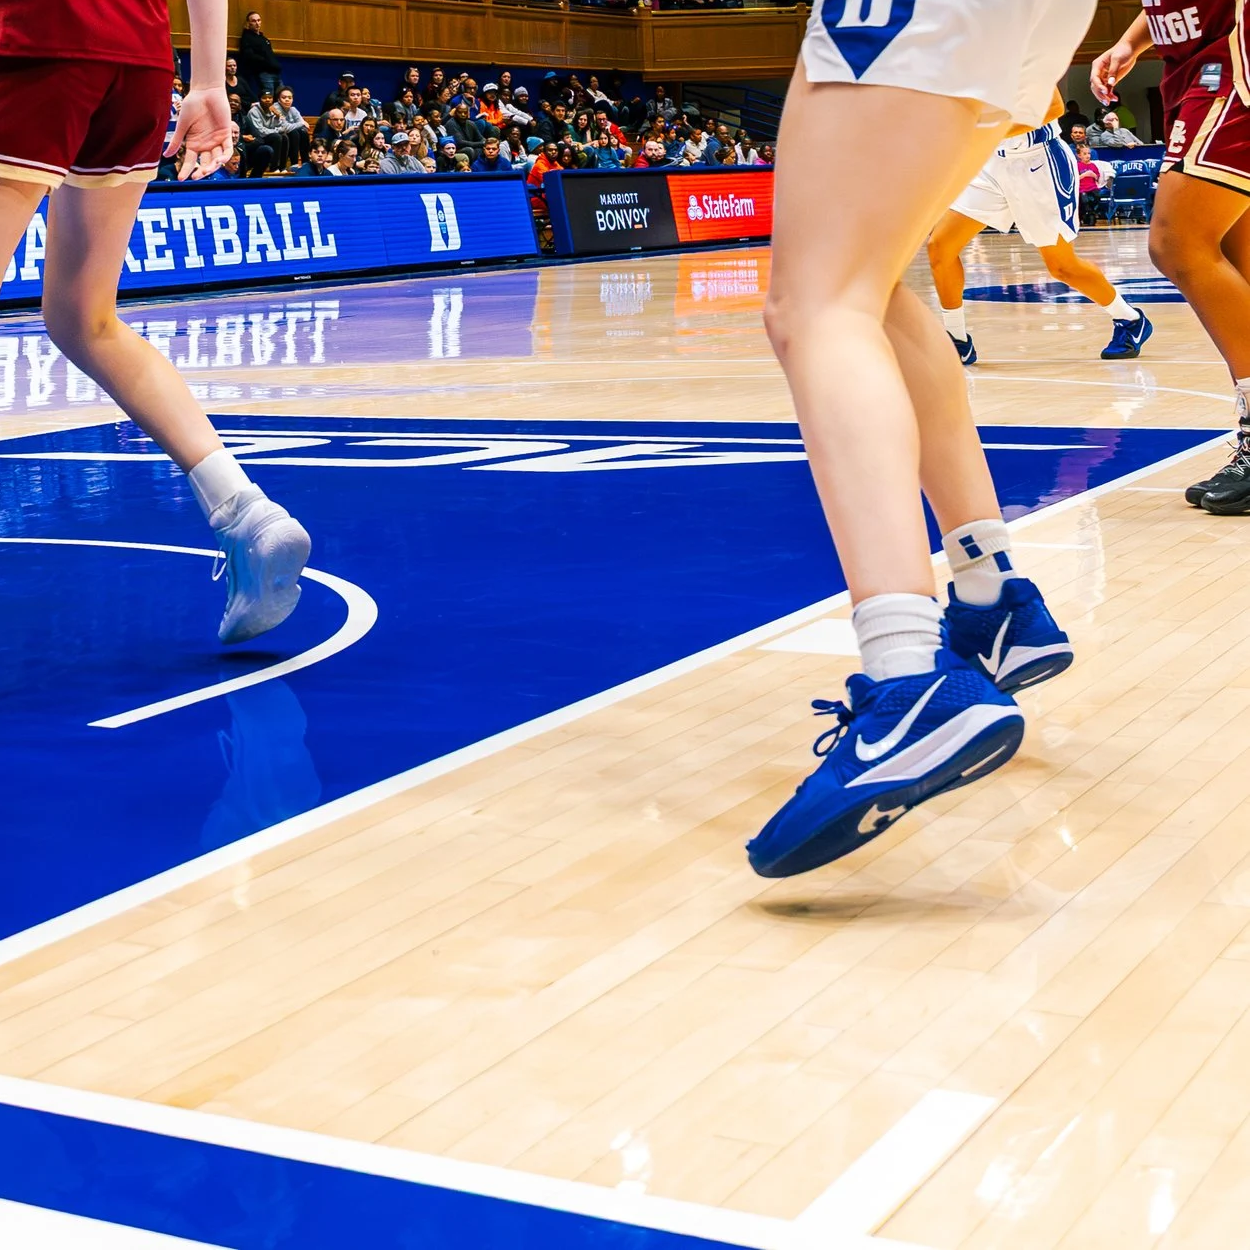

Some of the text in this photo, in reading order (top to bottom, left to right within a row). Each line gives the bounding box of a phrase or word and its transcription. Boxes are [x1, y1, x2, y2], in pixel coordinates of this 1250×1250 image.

[1122, 161, 1143, 172] DUKE
[600, 192, 639, 206] MARRIOTT
[596, 207, 649, 232] BONVOY
[1, 201, 338, 283] AETBALL
